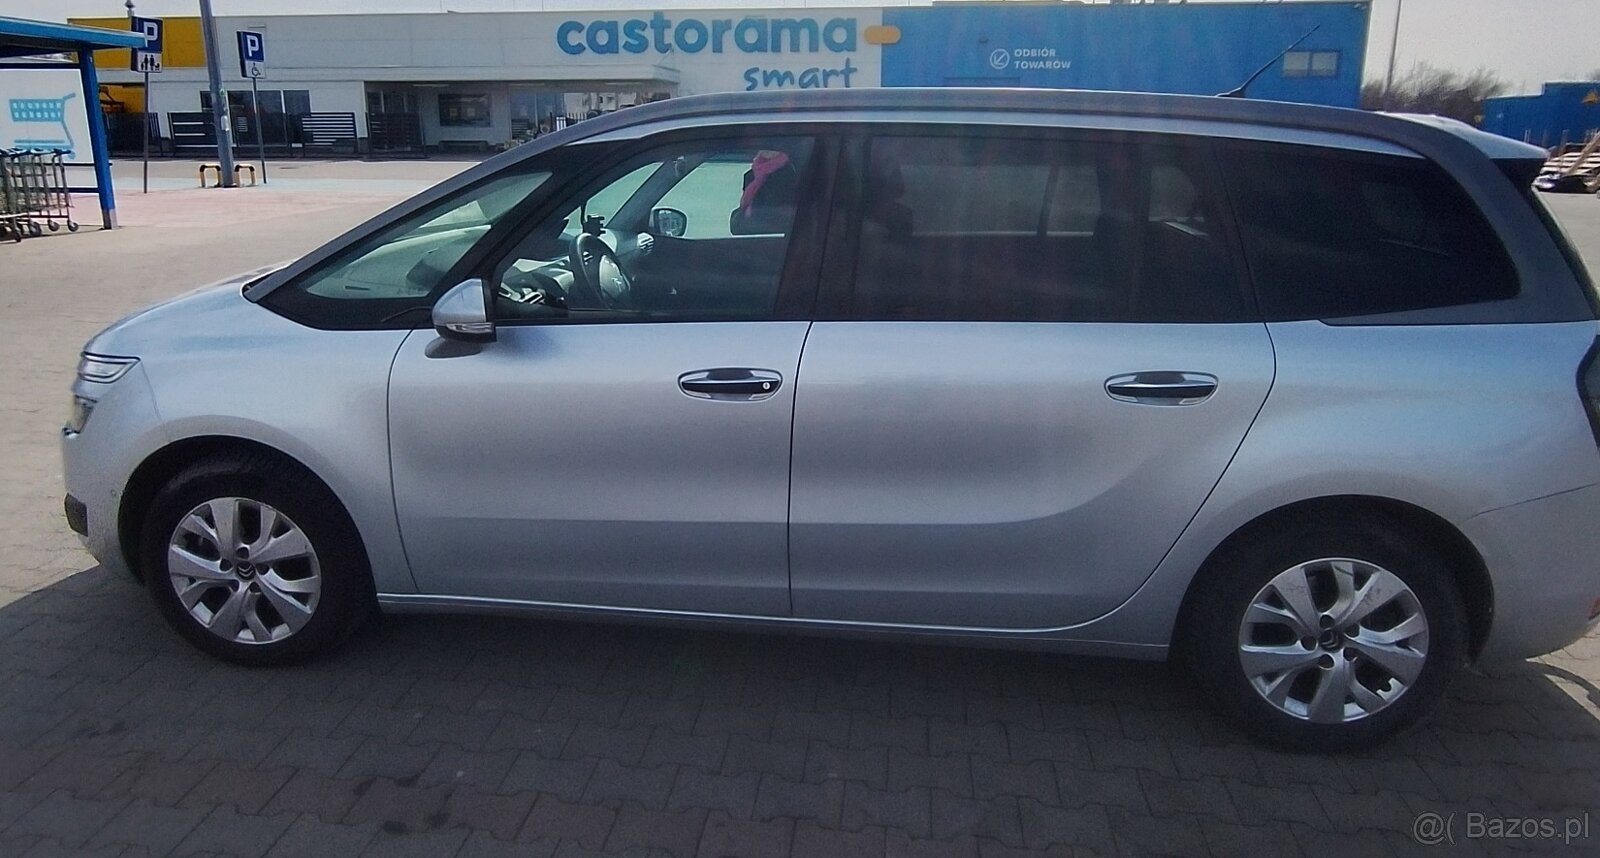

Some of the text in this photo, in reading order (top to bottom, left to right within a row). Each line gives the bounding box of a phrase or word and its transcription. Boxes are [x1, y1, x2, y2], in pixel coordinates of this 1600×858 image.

[143, 21, 158, 45] P
[556, 12, 857, 55] castorama
[246, 34, 259, 57] P
[1014, 47, 1056, 57] ODBIÓR
[743, 58, 858, 91] smart
